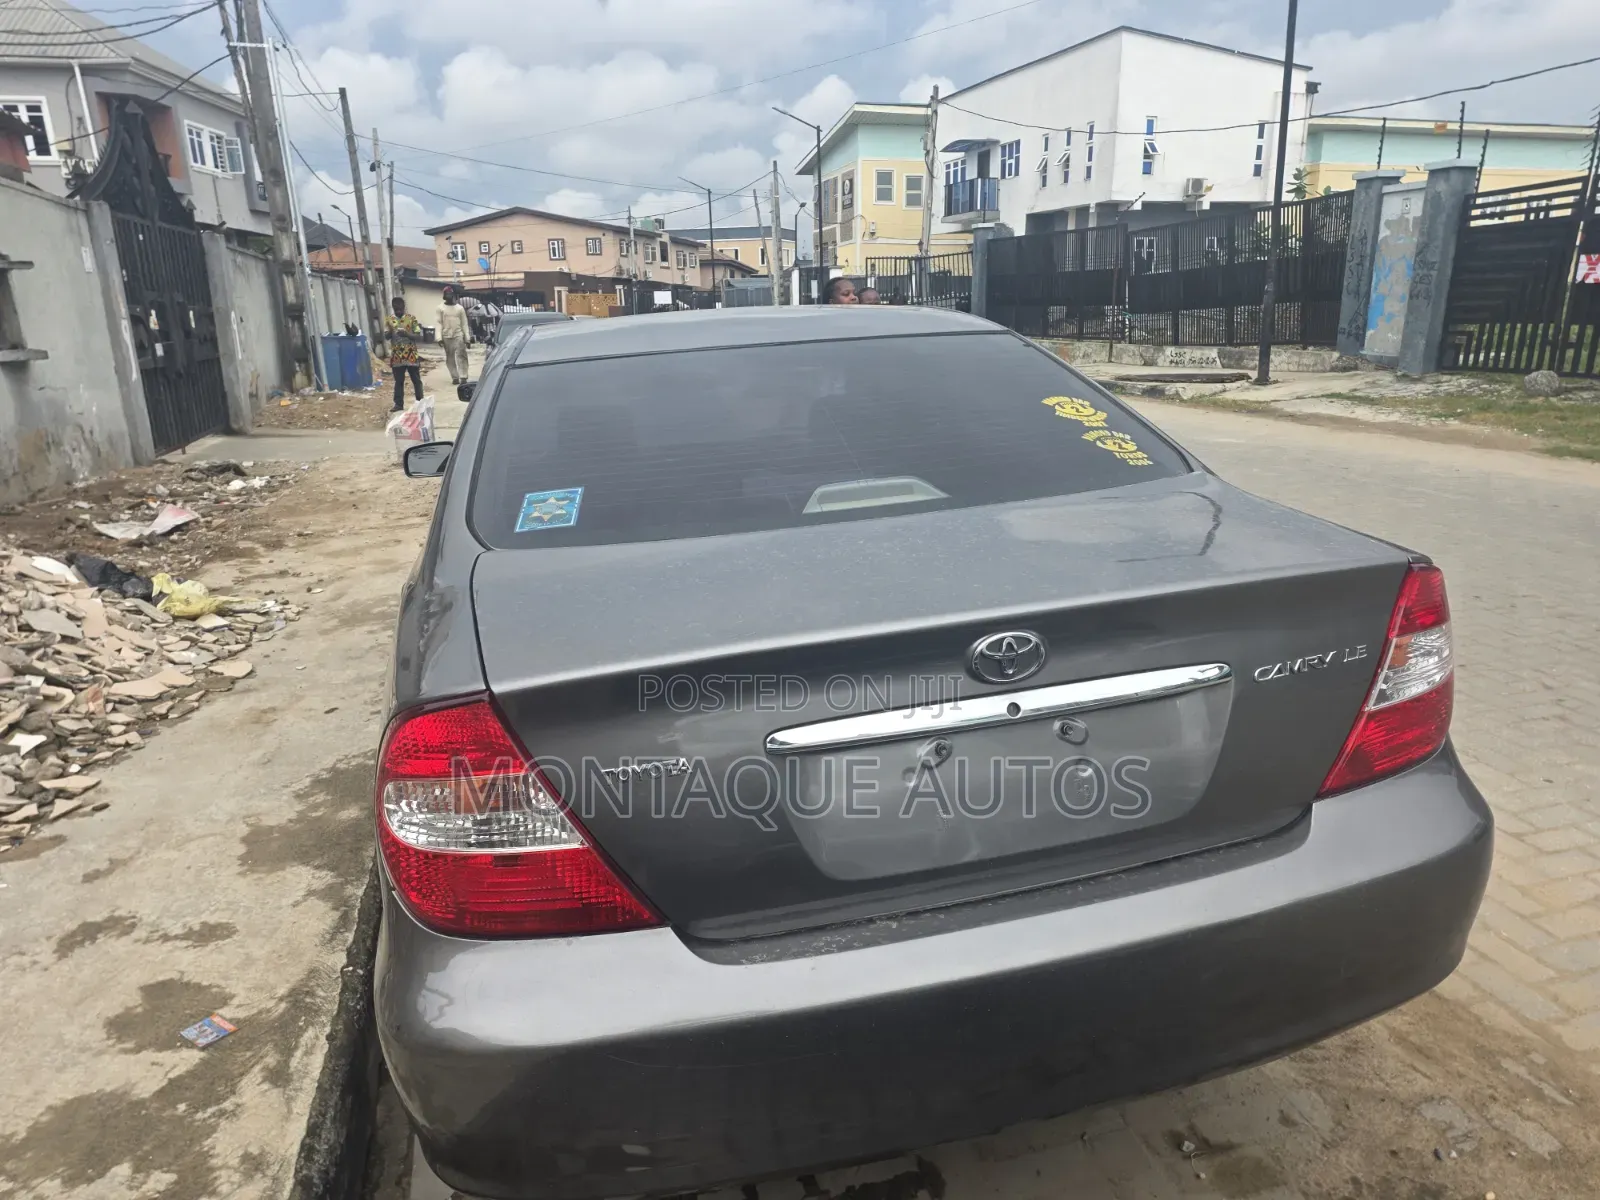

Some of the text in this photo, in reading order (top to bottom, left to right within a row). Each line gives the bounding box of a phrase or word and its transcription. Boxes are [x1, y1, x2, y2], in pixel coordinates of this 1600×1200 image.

[1252, 644, 1368, 683] CAMRY LE
[601, 756, 693, 786] TOYOTA
